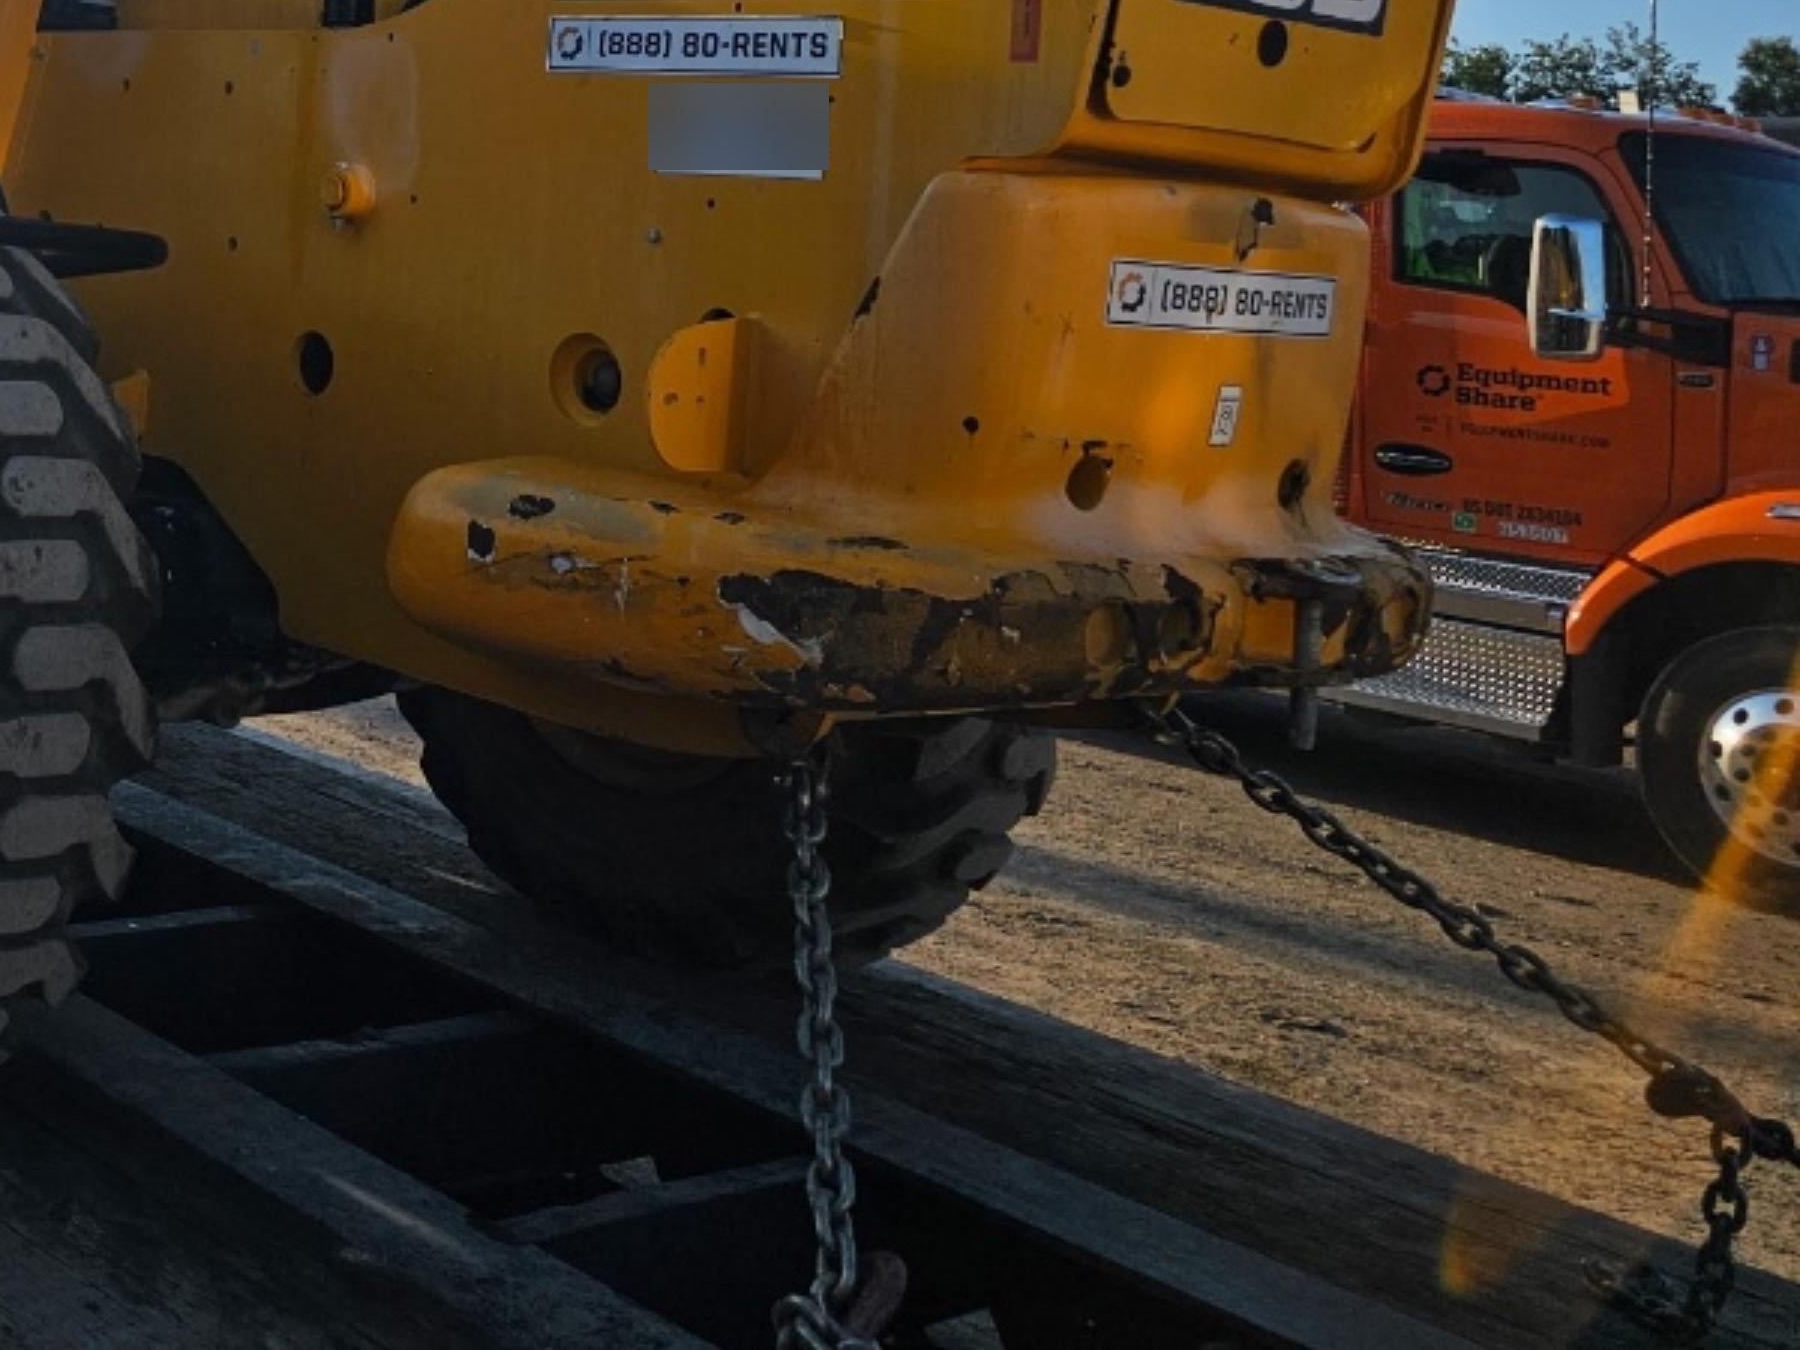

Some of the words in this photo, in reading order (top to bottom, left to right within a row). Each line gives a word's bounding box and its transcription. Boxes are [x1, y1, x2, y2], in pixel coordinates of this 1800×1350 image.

[598, 29, 672, 59] (888)
[682, 30, 828, 58] 80-RENTS
[1160, 279, 1228, 316] (888)
[1235, 288, 1328, 319] 80-RENTS
[1455, 362, 1613, 396] Equipment
[1455, 386, 1536, 411] Share
